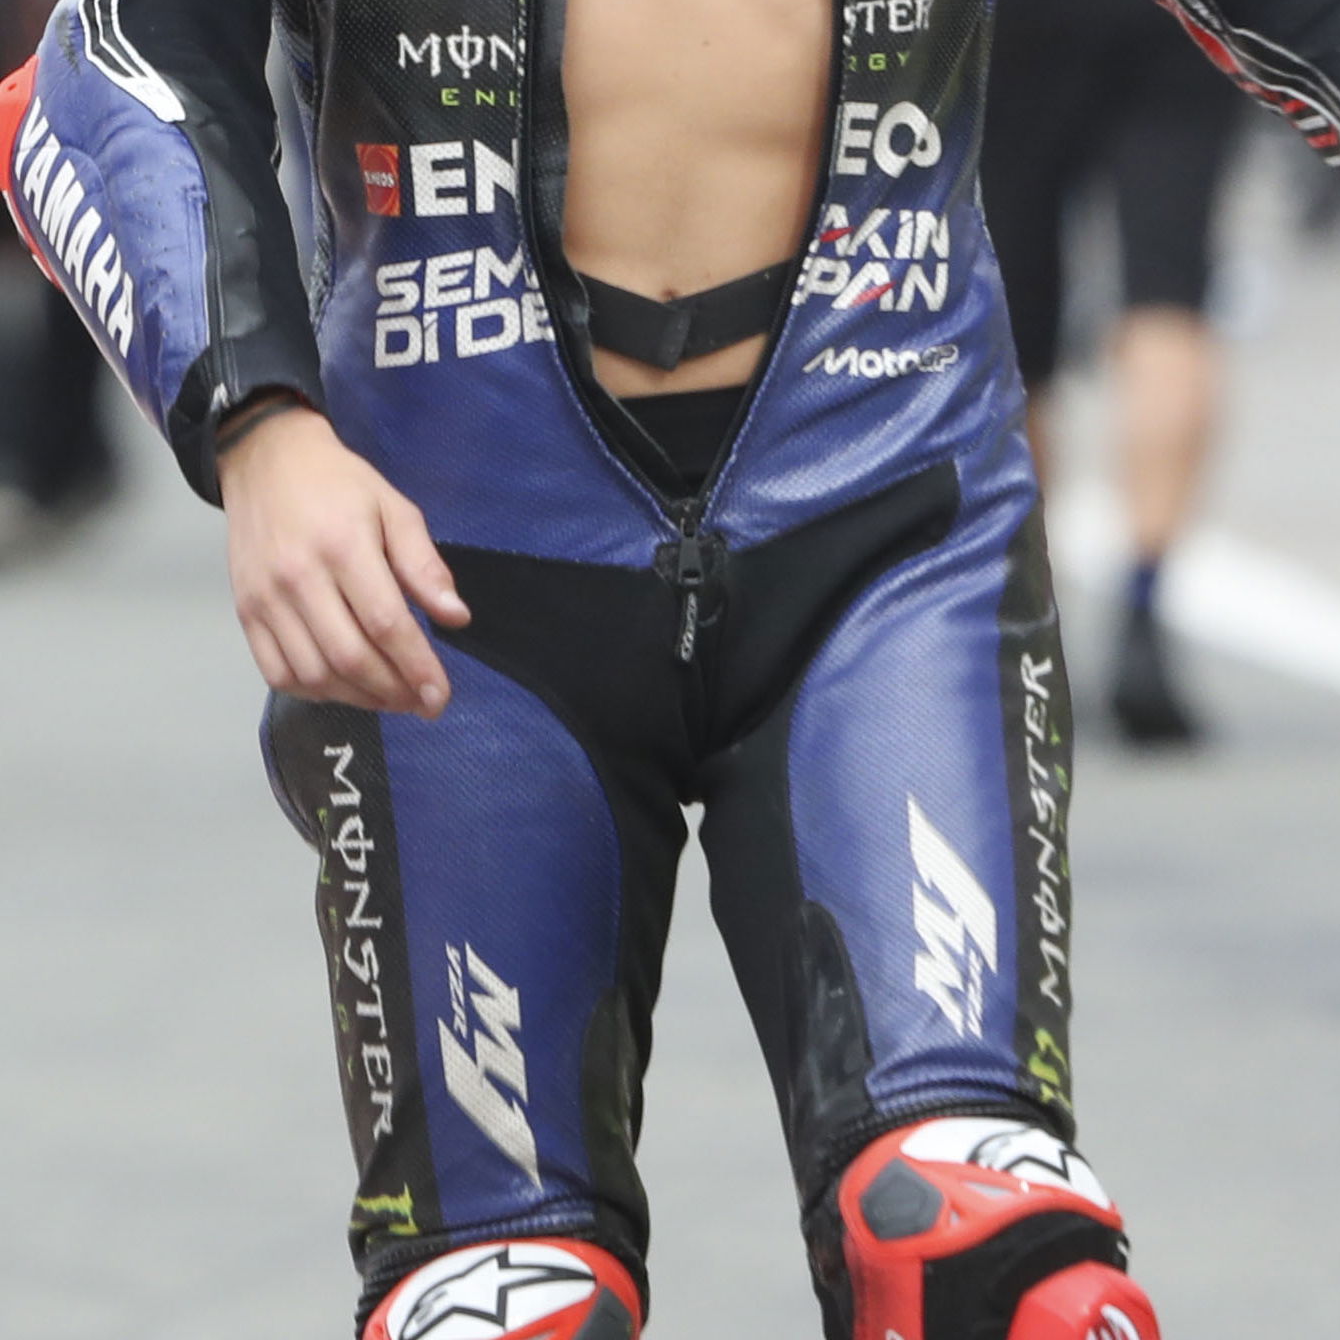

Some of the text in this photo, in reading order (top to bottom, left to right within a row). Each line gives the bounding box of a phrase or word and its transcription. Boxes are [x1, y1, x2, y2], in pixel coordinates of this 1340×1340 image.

[441, 88, 518, 107] EN
[15, 96, 133, 358] YAMAHA
[375, 244, 539, 315] SEM
[791, 256, 950, 312] PAN
[1021, 653, 1067, 1006] MONSTER
[325, 743, 393, 1140] MONSTER
[445, 941, 468, 1039] YZR
